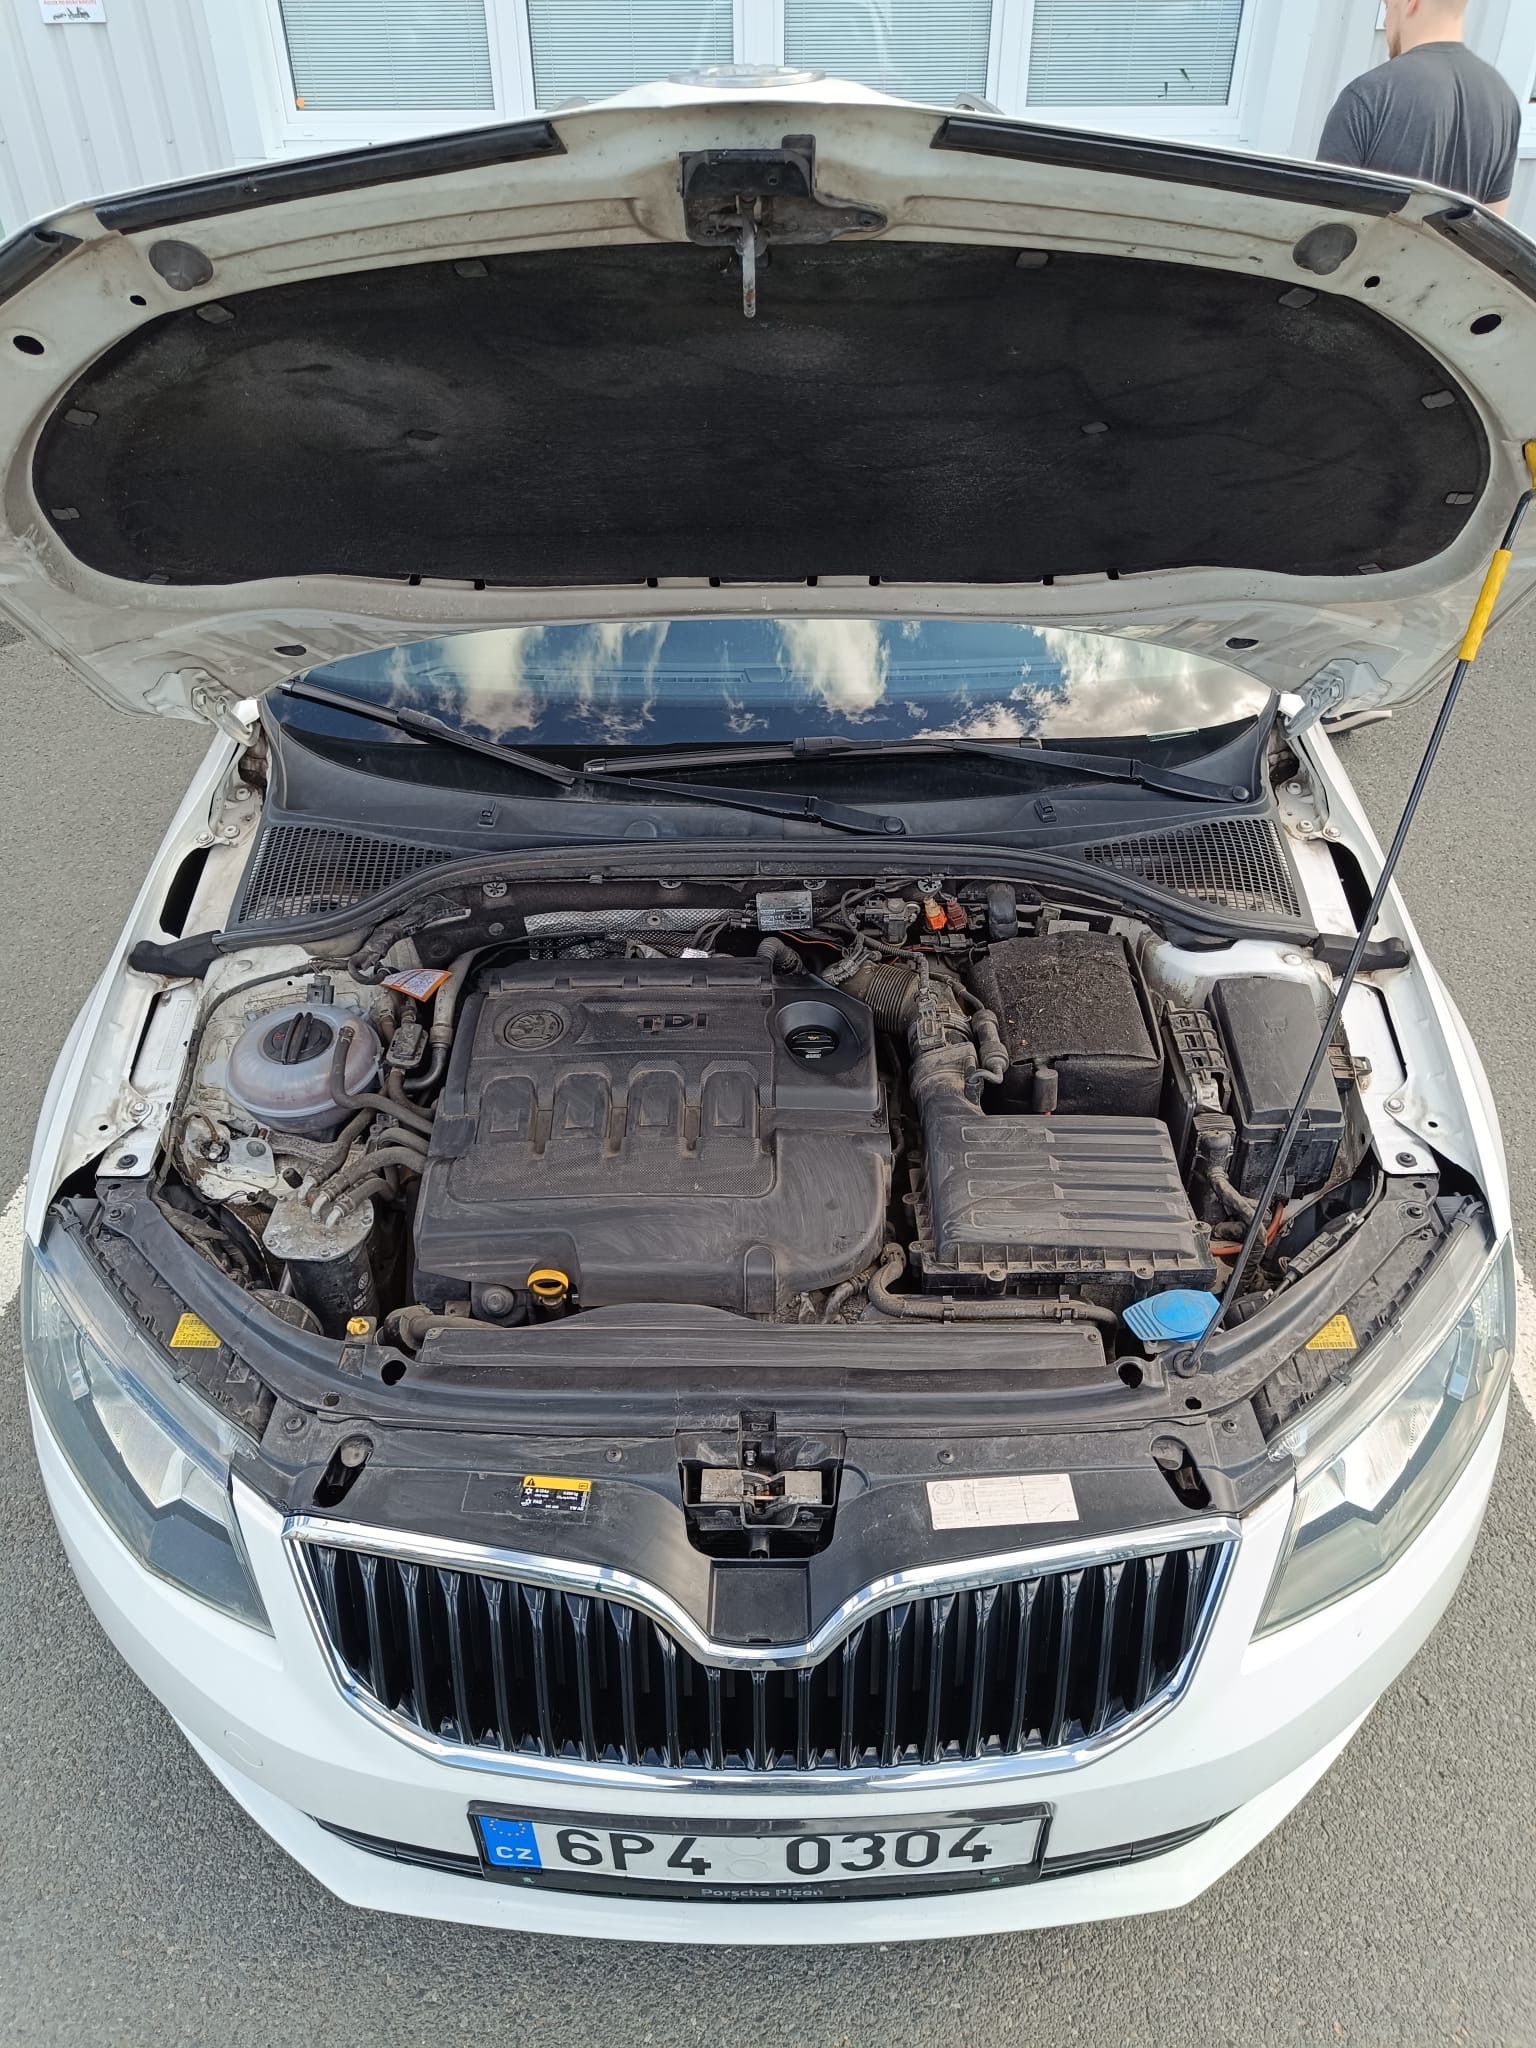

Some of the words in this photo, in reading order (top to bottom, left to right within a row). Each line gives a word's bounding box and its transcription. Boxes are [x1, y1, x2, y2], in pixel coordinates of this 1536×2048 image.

[637, 1013, 709, 1032] TDI
[496, 1846, 533, 1861] CZ
[556, 1828, 712, 1876] 6P4
[786, 1826, 993, 1876] 0304
[701, 1888, 770, 1897] Porsche
